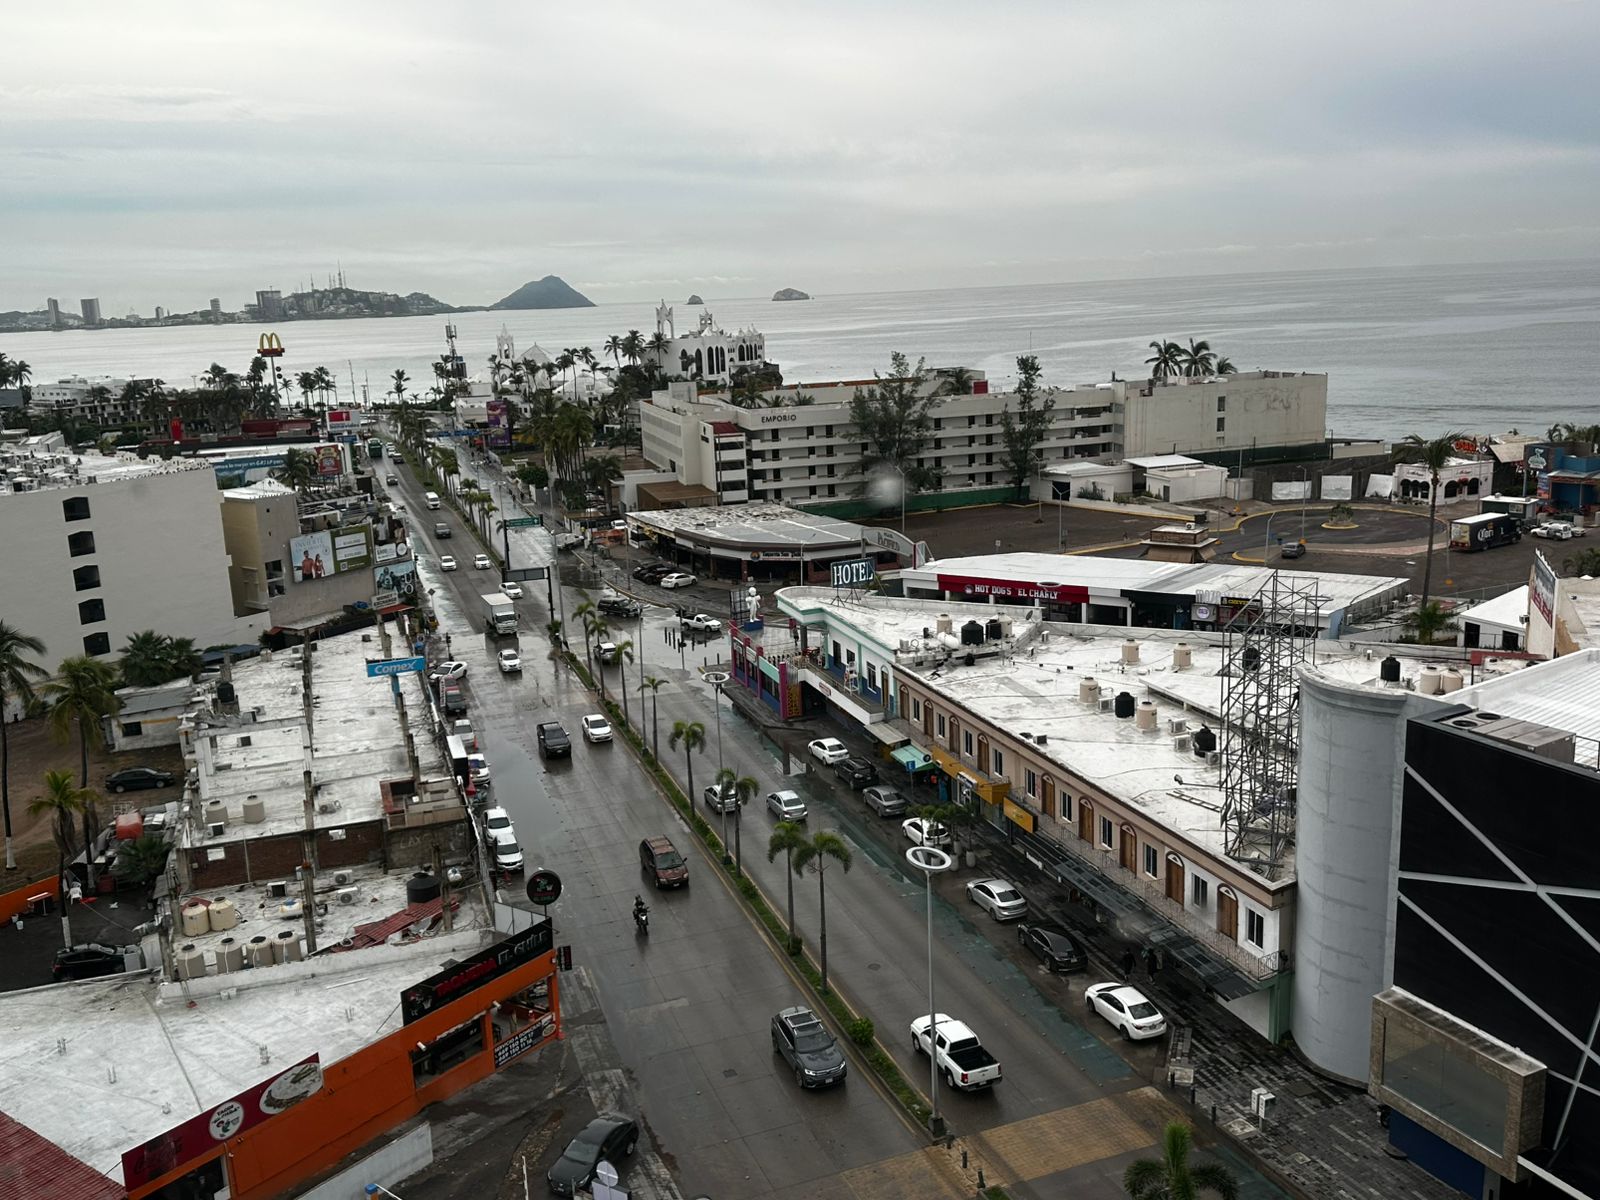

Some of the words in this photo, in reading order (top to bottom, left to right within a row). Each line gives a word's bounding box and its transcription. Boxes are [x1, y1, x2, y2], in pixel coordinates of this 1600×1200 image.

[761, 414, 797, 423] EMPORIO
[833, 561, 874, 586] HOTEL
[974, 584, 990, 594] HOT
[374, 660, 417, 674] Comex
